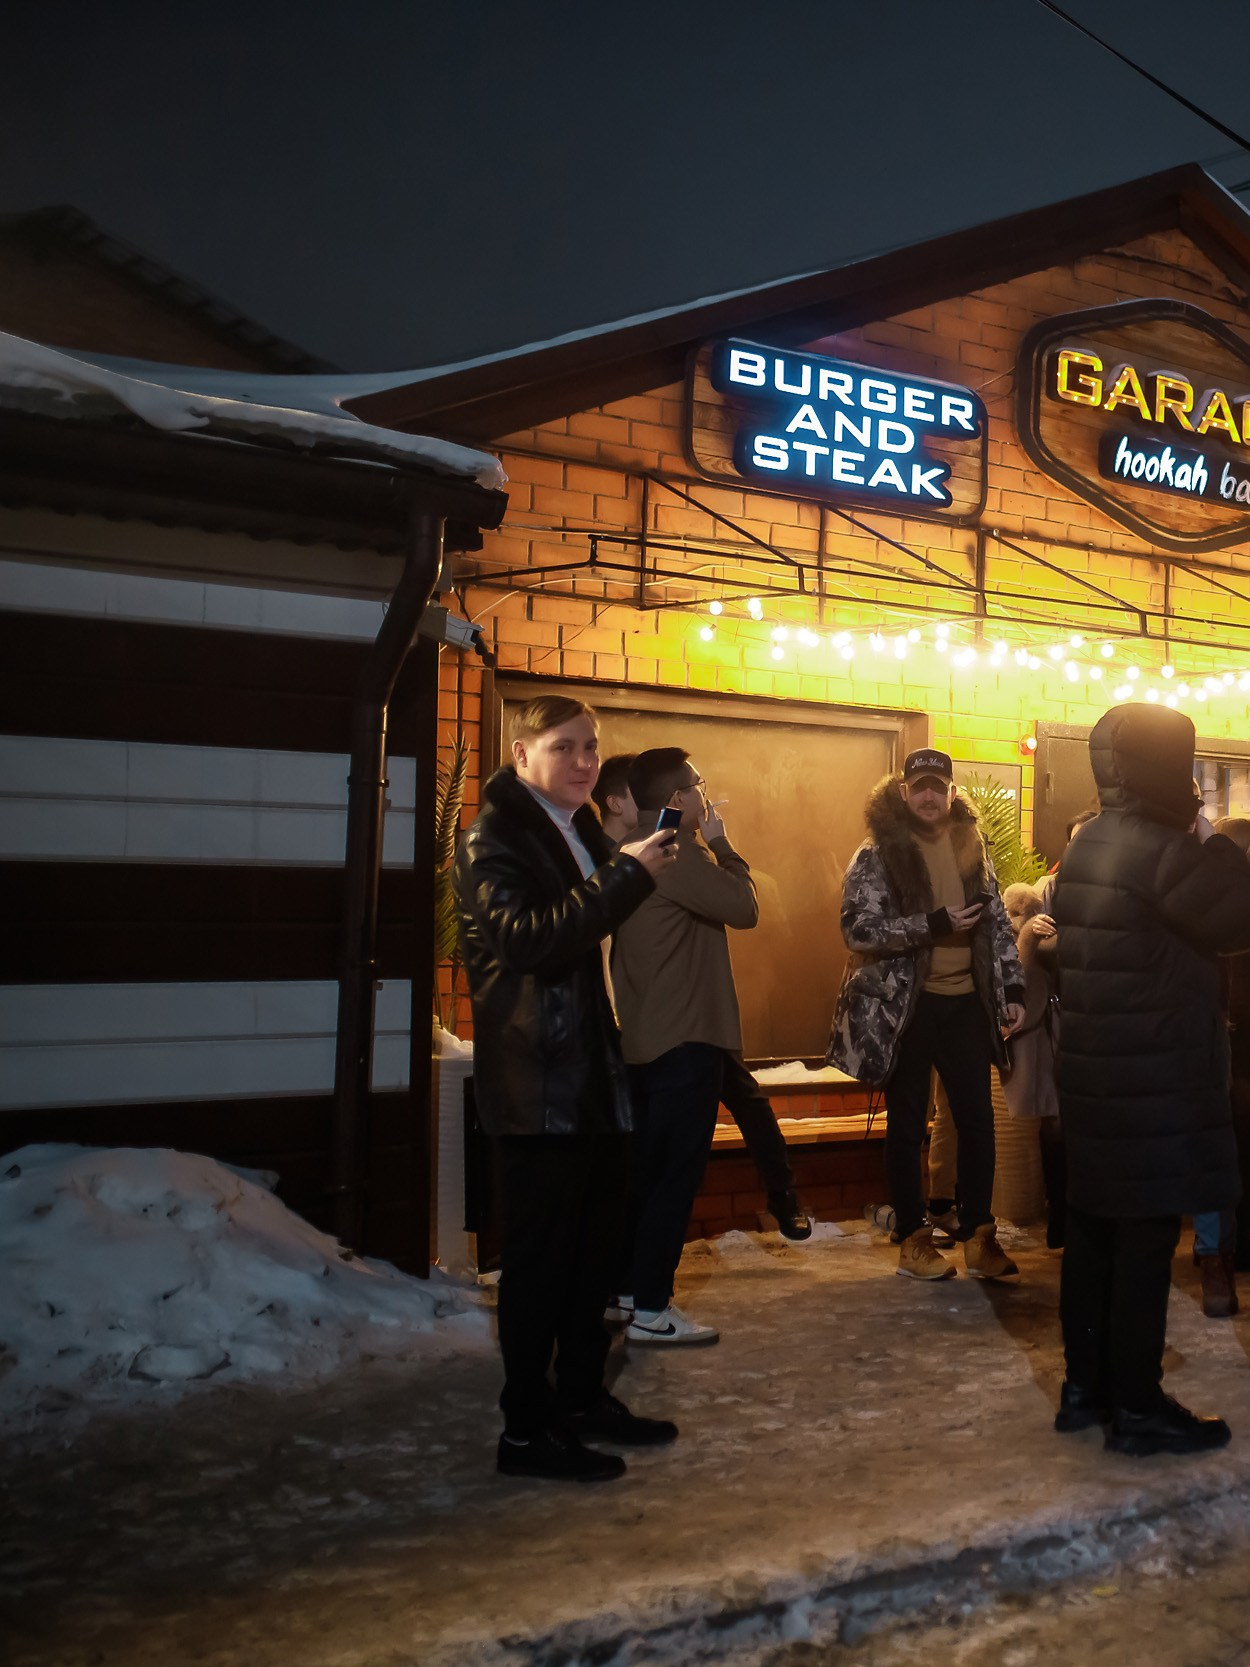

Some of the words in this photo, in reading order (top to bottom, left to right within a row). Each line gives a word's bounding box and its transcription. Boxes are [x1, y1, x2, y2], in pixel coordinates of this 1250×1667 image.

[729, 349, 974, 431] BURGER
[785, 404, 915, 454] AND
[752, 435, 946, 500] STEAK
[1114, 435, 1208, 495] hookah
